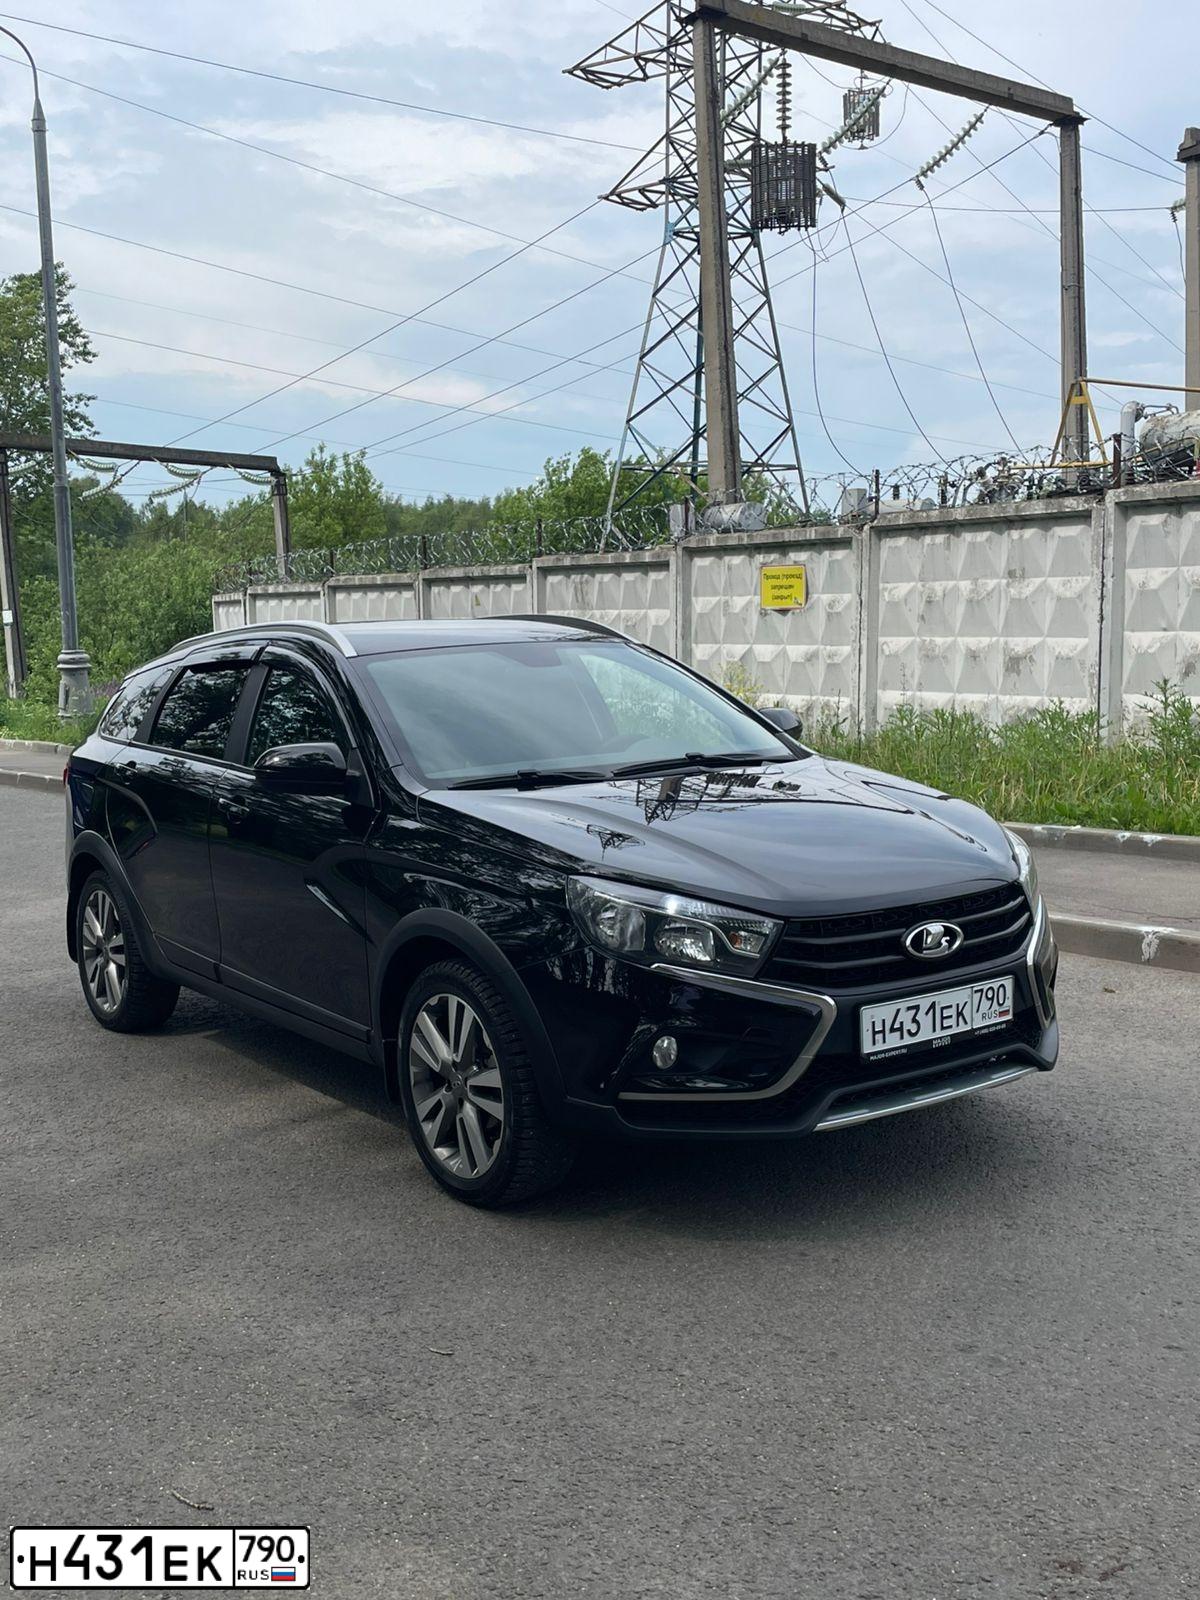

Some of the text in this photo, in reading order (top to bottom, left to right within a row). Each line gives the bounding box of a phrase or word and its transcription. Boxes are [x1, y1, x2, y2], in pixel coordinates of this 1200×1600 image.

[974, 983, 1007, 1013] 790
[981, 1010, 998, 1021] RUS
[932, 1036, 951, 1044] MAJOR
